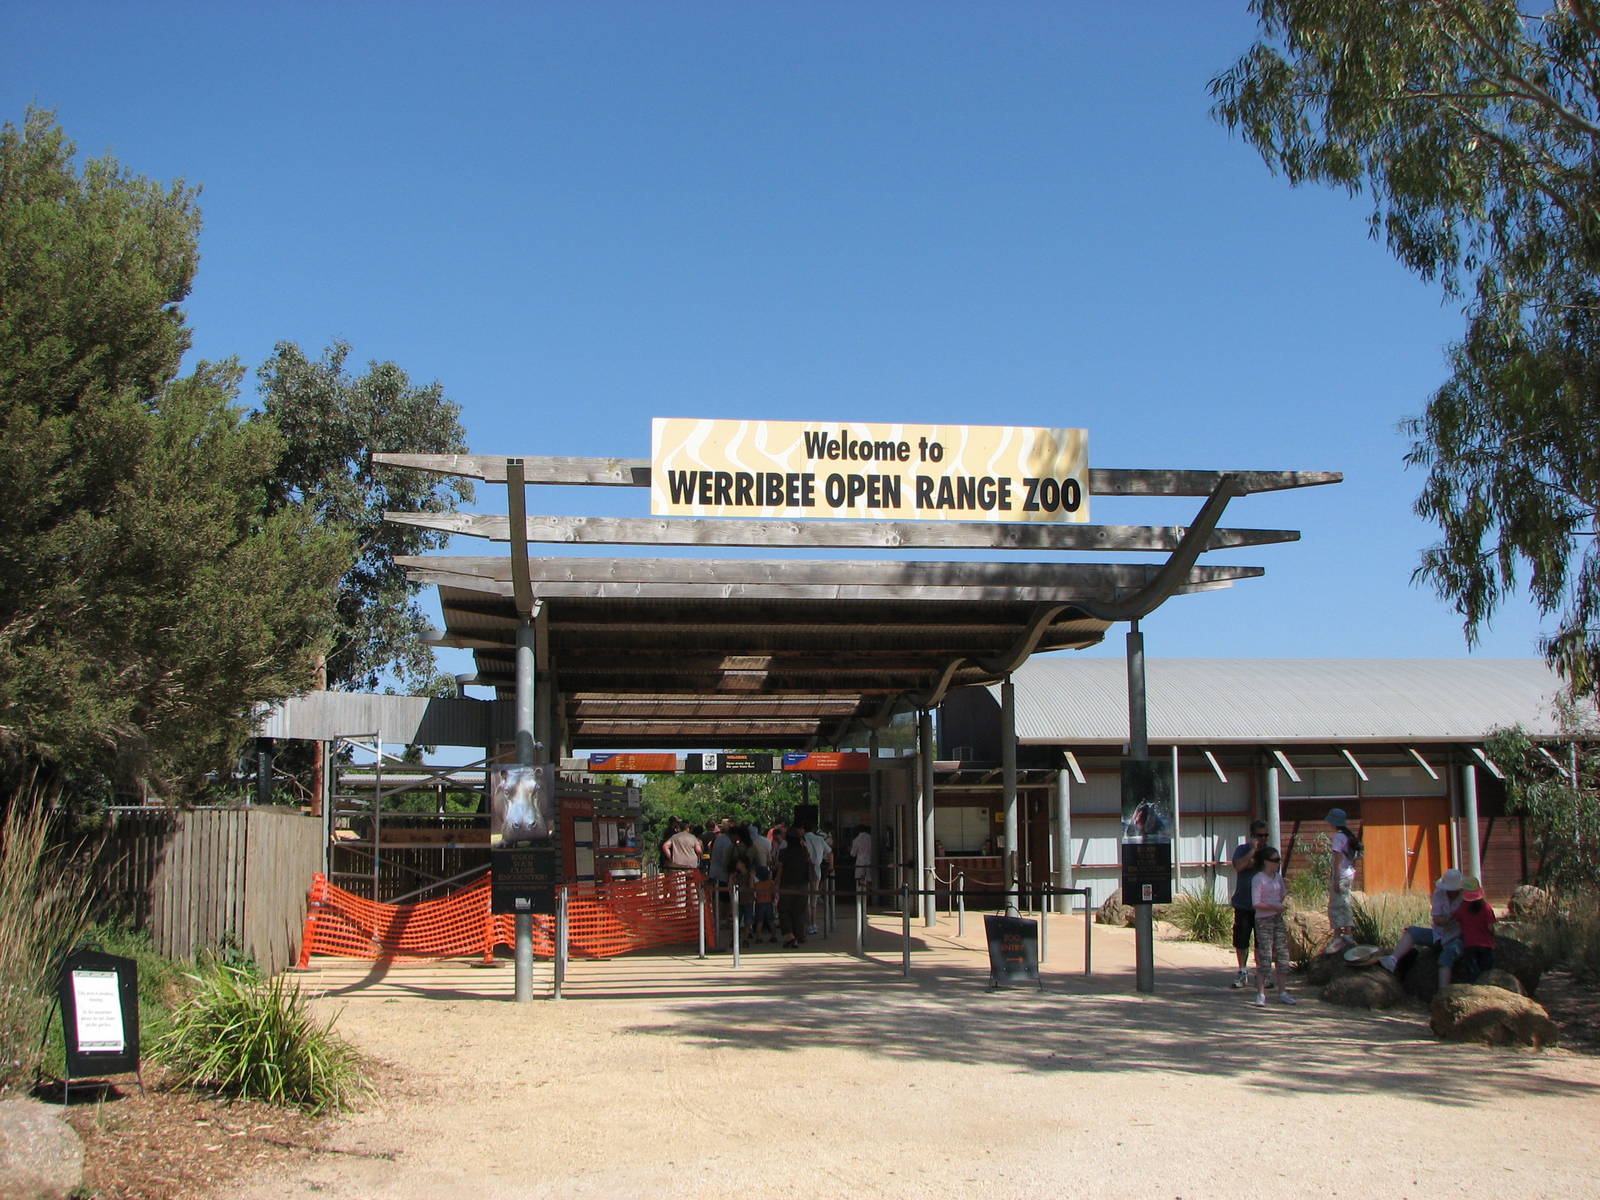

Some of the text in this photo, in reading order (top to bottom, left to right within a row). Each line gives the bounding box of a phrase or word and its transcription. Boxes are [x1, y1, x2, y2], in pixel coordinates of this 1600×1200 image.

[804, 430, 944, 463] Welcome to
[668, 470, 1082, 513] WERRIBEE OPEN RANGE ZOO
